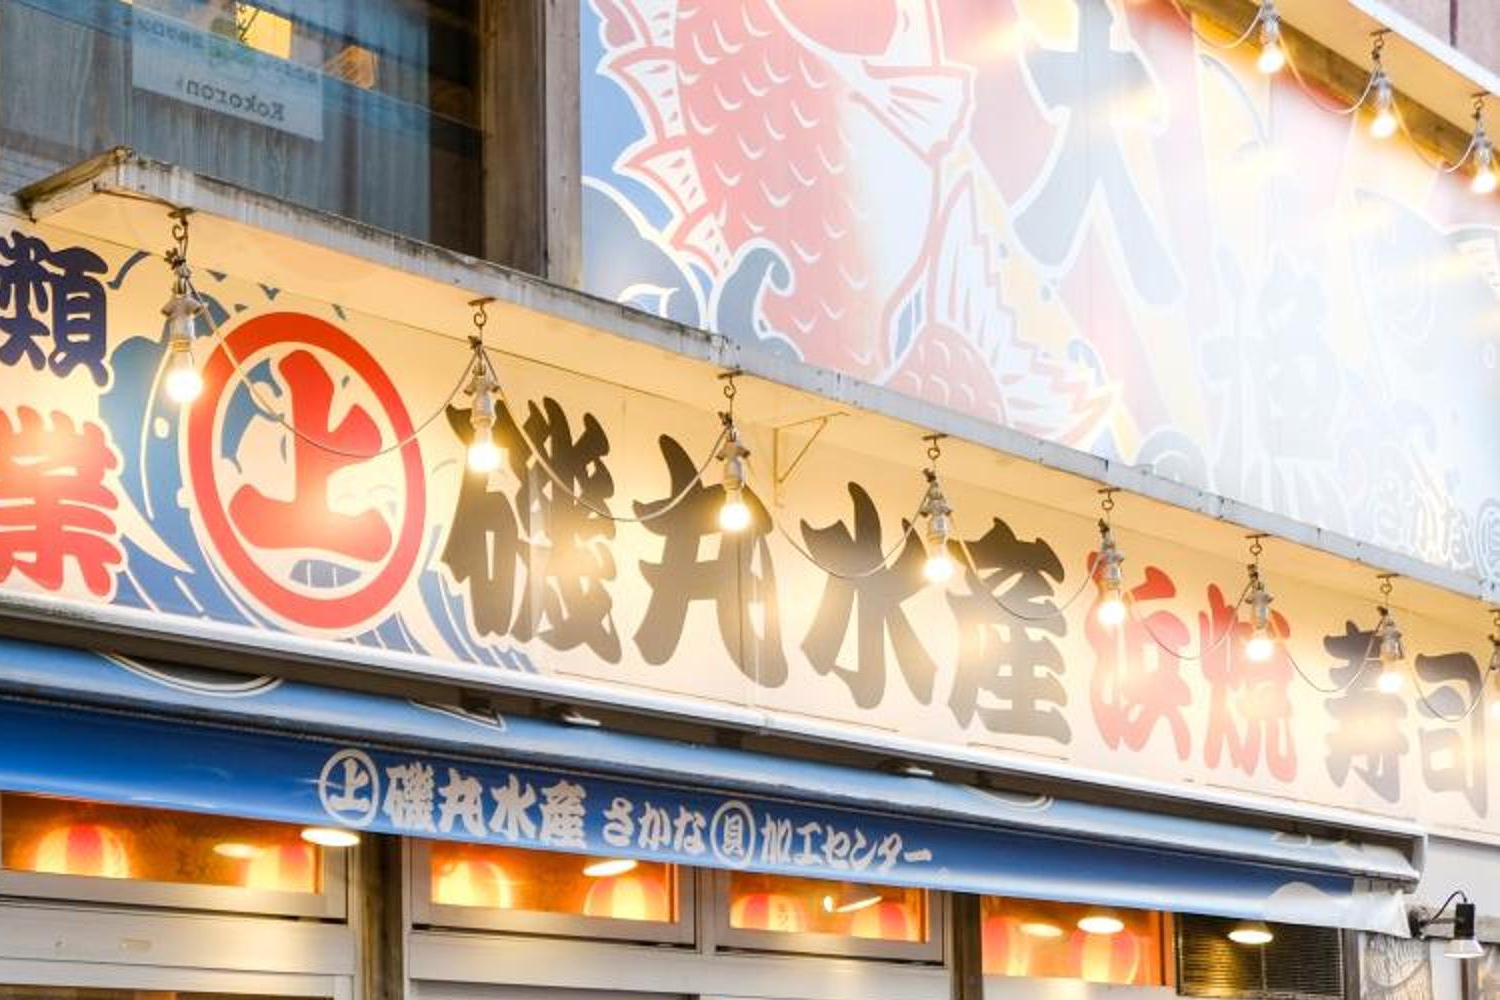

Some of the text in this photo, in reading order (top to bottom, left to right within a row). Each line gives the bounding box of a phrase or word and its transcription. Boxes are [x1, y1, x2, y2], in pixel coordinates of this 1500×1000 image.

[442, 394, 1071, 746] 磯丸水産
[1085, 545, 1299, 782] 浜焼
[1323, 621, 1485, 816] 寿司
[382, 762, 587, 852] 磯丸水産
